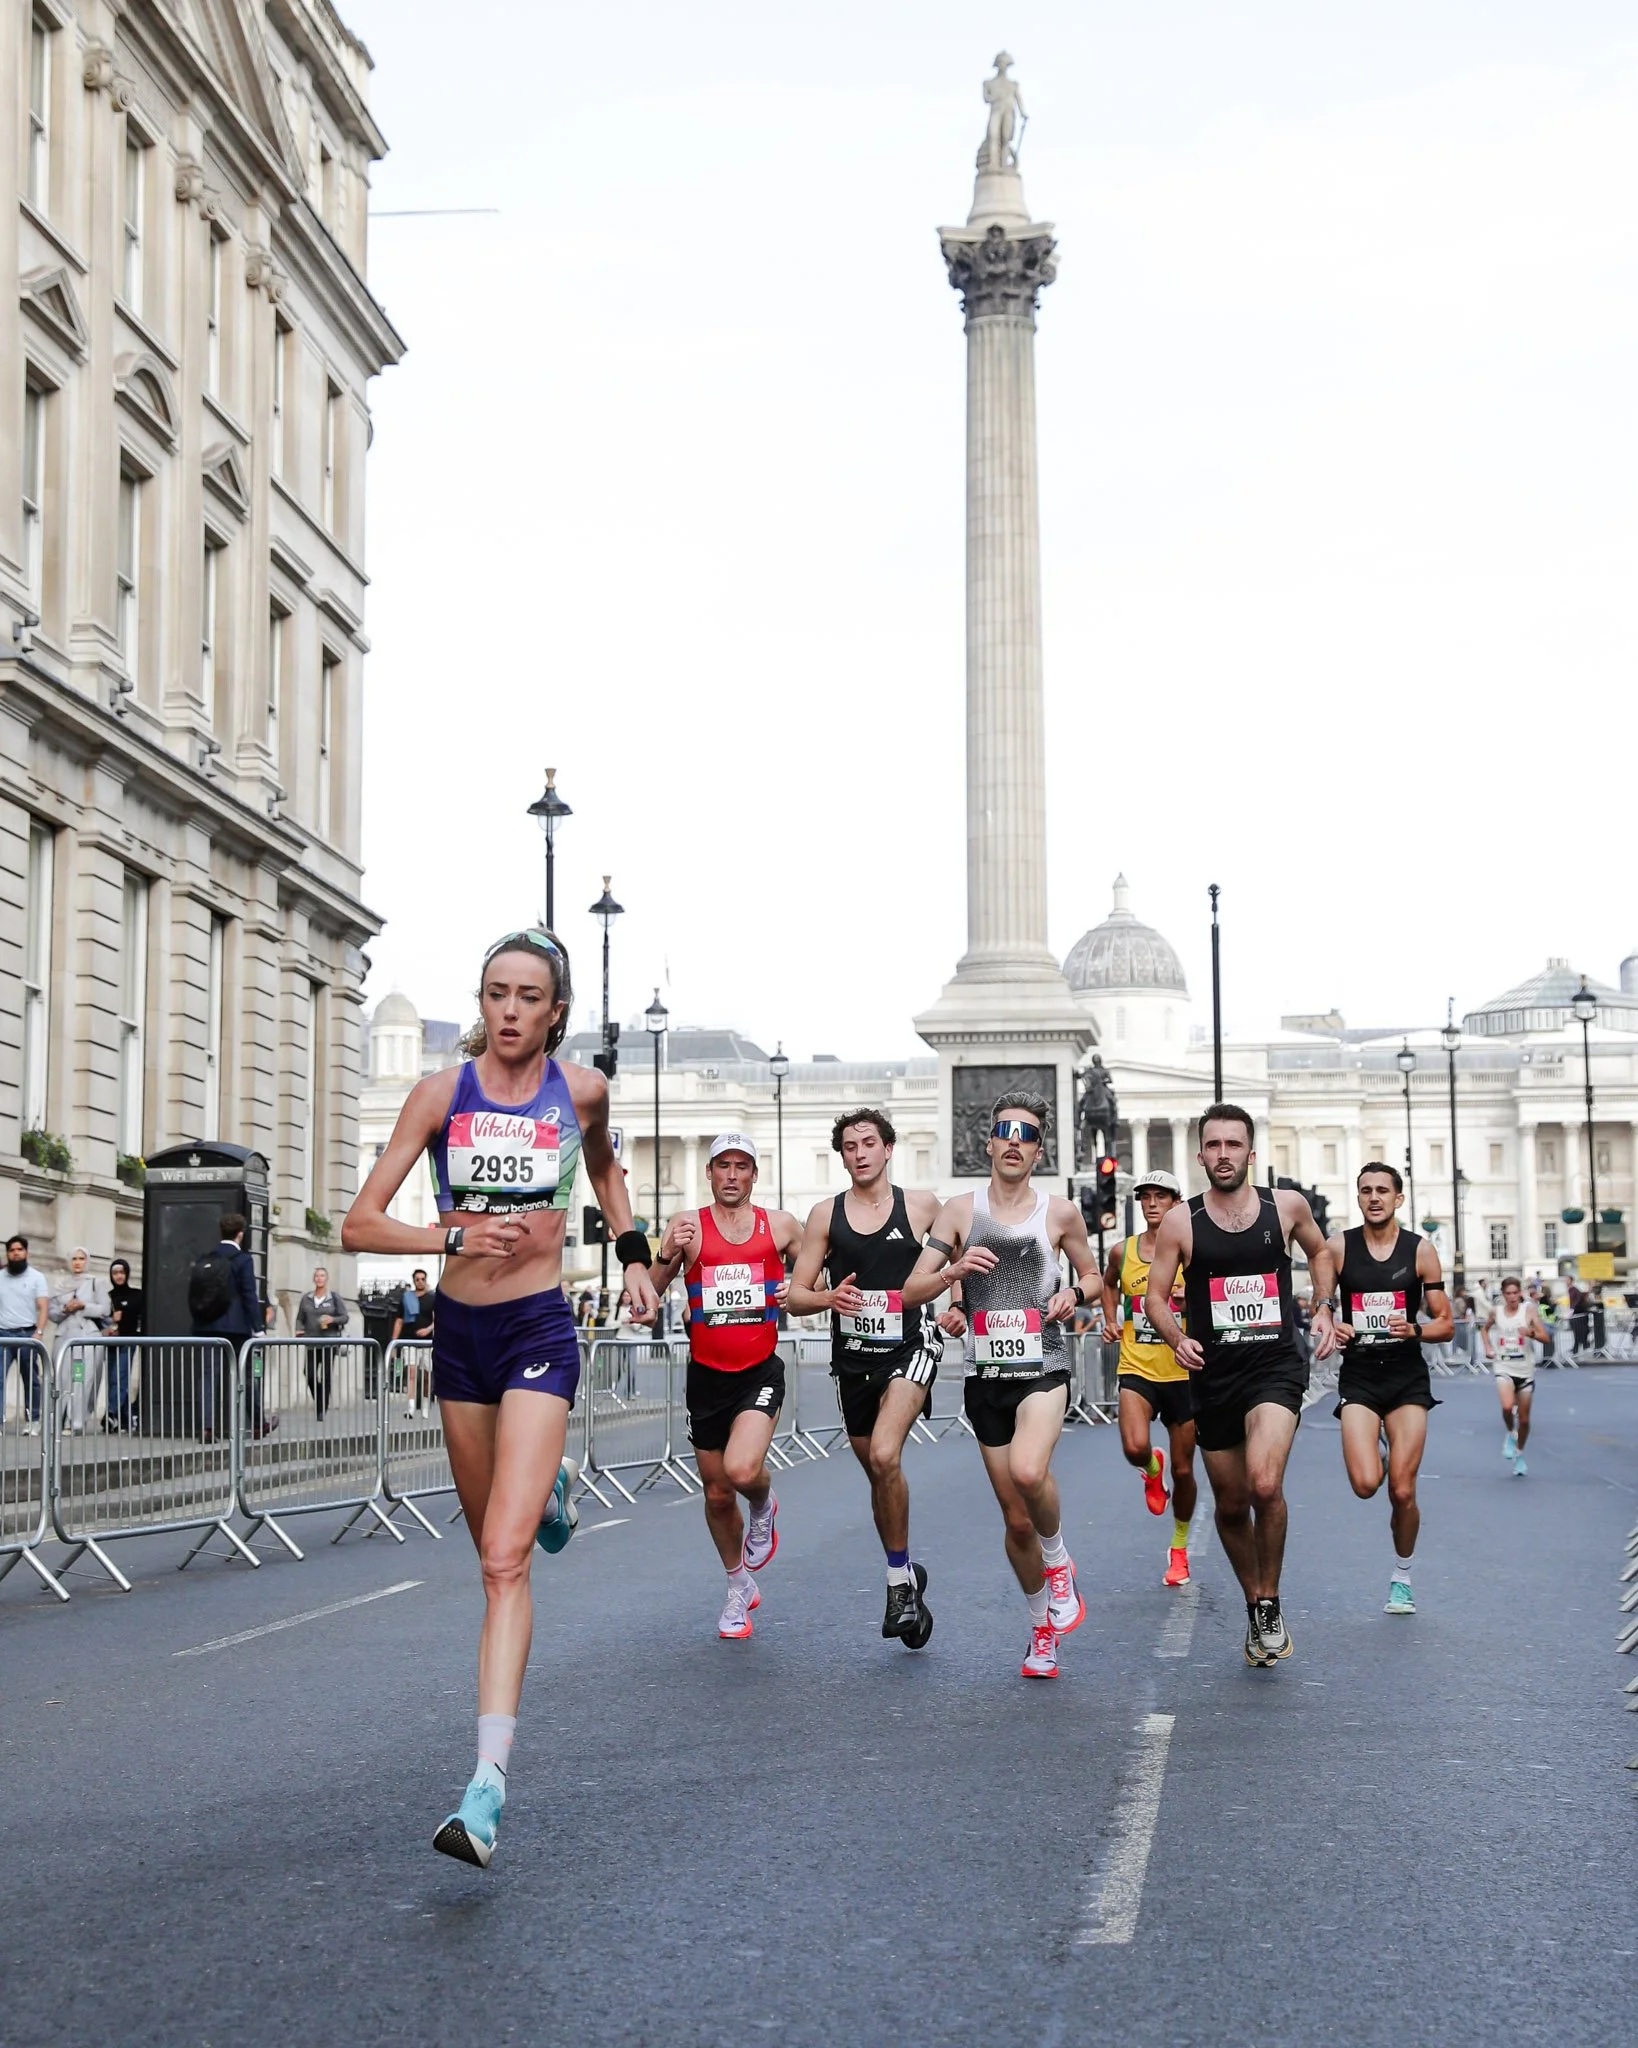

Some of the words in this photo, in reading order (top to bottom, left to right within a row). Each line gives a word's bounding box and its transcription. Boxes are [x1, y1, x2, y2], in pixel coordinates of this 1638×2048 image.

[474, 1112, 533, 1147] Vitality
[161, 1171, 186, 1181] WiFi
[189, 1171, 214, 1181] ere
[471, 1155, 534, 1183] 2935
[488, 1205, 511, 1214] new
[511, 1199, 549, 1213] balance
[716, 1266, 750, 1283] Vitality
[1131, 1275, 1149, 1288] COR
[1226, 1278, 1264, 1296] Vitality
[716, 1289, 752, 1307] 8925
[1363, 1294, 1394, 1310] Vitality
[1230, 1303, 1263, 1322] 1007
[1366, 1314, 1388, 1329] 100
[854, 1316, 886, 1334] 6614
[987, 1312, 1025, 1333] Vitality
[989, 1338, 1025, 1358] 1339
